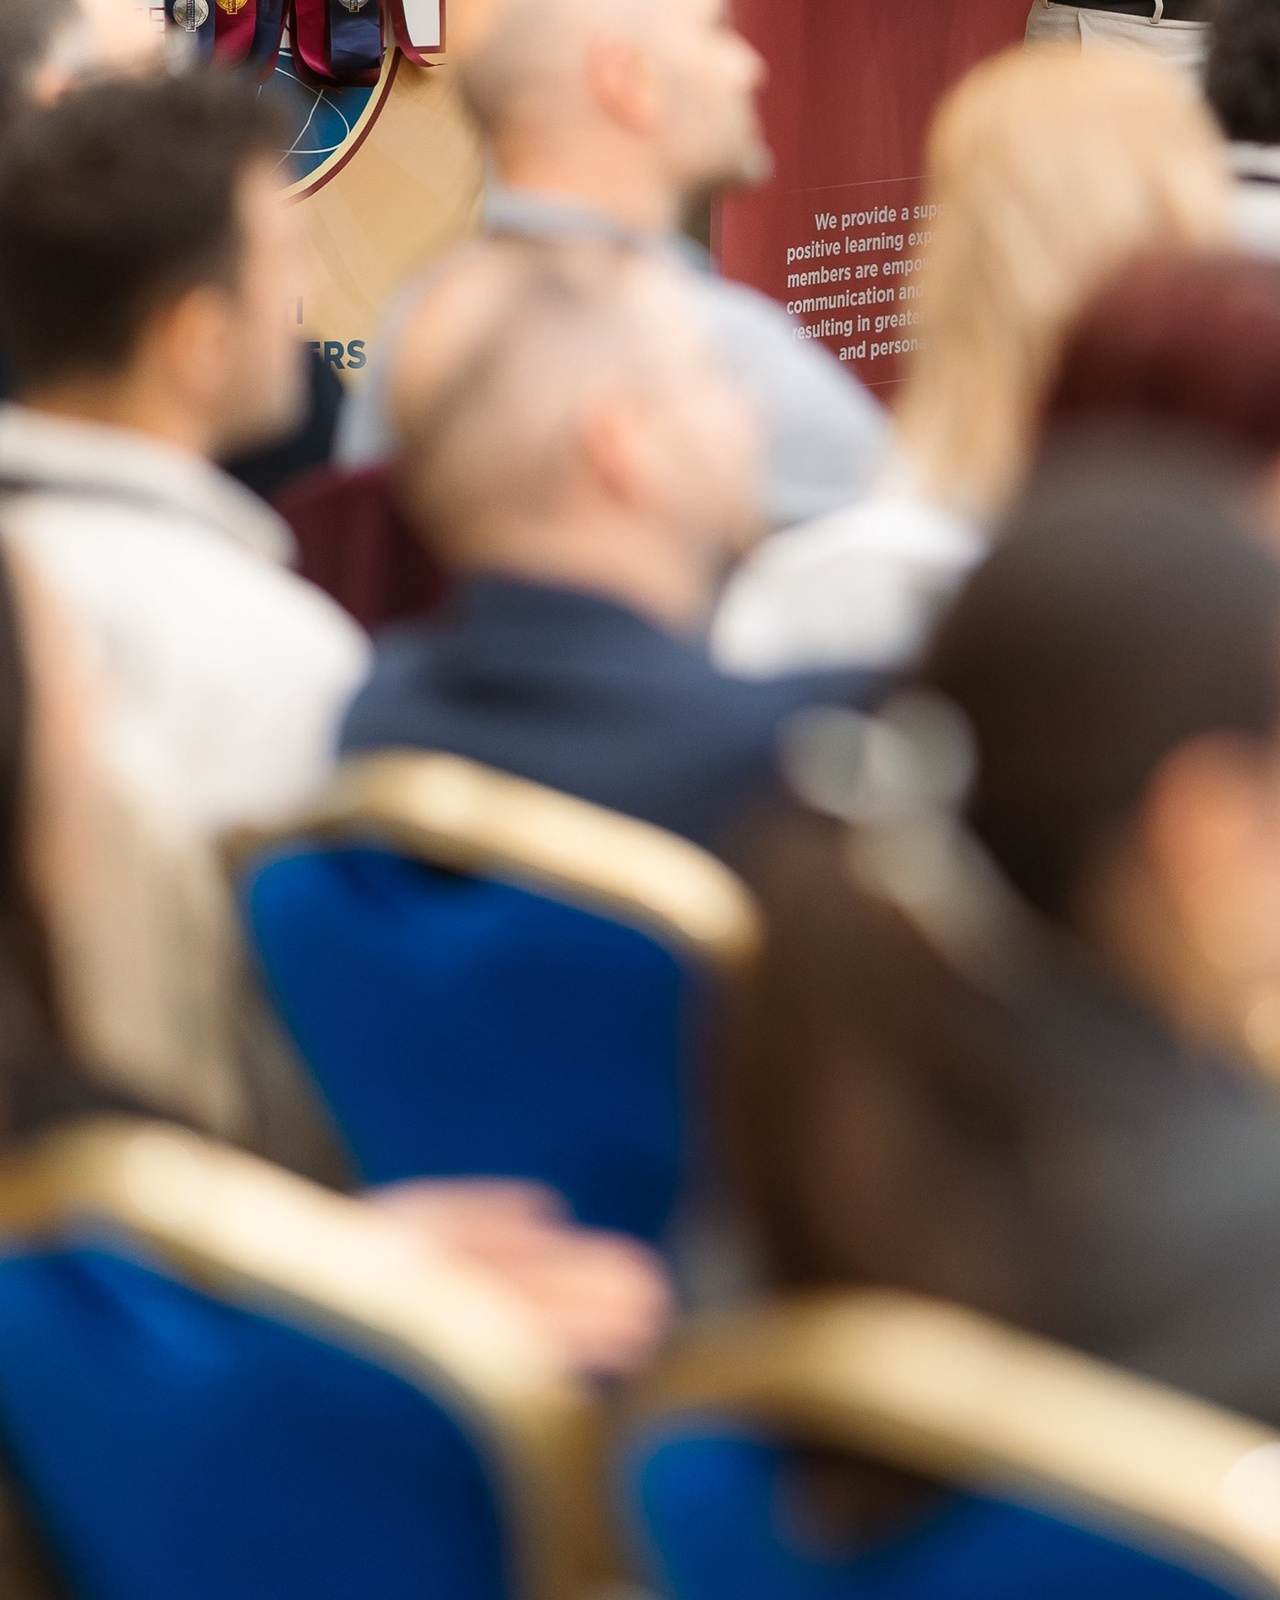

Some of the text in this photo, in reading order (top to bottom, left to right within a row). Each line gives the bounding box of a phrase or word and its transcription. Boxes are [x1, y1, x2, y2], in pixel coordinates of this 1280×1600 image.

[814, 212, 838, 231] We
[841, 205, 897, 231] provide
[901, 207, 909, 221] a
[786, 239, 841, 265] positive
[845, 232, 904, 254] learning
[787, 265, 852, 289] members
[855, 263, 879, 279] are
[786, 286, 895, 315] communication
[792, 317, 853, 338] resulting
[857, 314, 871, 332] in
[839, 340, 866, 361] and
